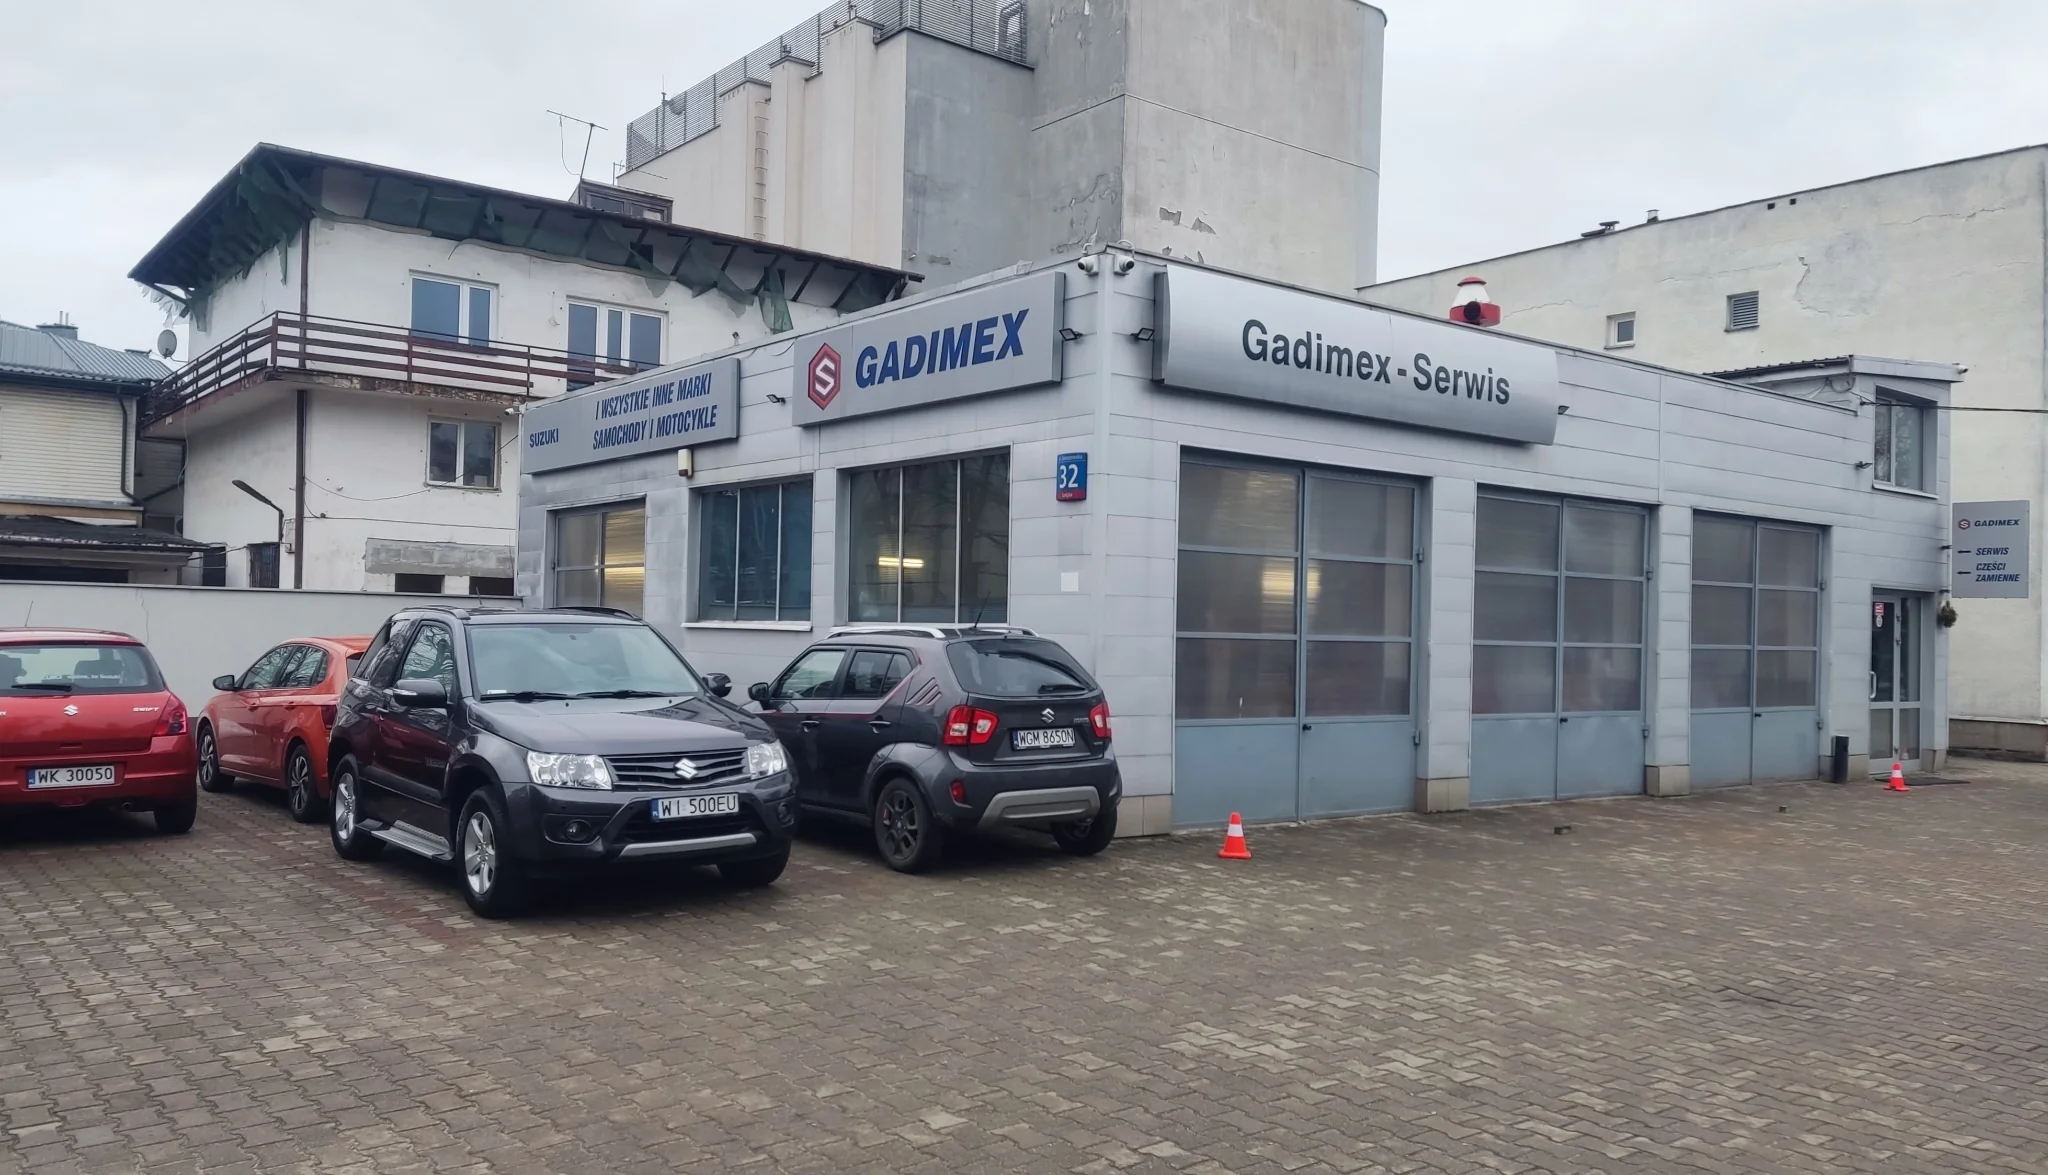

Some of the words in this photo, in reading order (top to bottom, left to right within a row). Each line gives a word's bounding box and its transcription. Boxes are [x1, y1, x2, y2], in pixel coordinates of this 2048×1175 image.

[855, 308, 1030, 389] GADIMEX
[595, 401, 600, 420] I
[601, 388, 650, 420] WSZYSTKIE
[652, 381, 675, 408] INNE
[676, 372, 712, 402] MARKI
[592, 419, 648, 450] SAMOCHODY
[649, 418, 654, 439] I
[655, 404, 718, 438] MOTOCYKLE
[529, 427, 560, 448] SUZUKI
[1060, 464, 1078, 488] 32
[1974, 519, 2020, 527] GADIMEX
[1975, 547, 2009, 556] SERWIS
[1976, 561, 2006, 571] CZĘŚCI
[1975, 573, 2020, 582] ZAMIENNE
[1019, 732, 1040, 745] WGM
[1043, 730, 1074, 743] 8650N
[38, 769, 60, 784] WK
[66, 767, 113, 782] 30050
[662, 800, 680, 816] WI
[689, 795, 736, 814] 500EU
